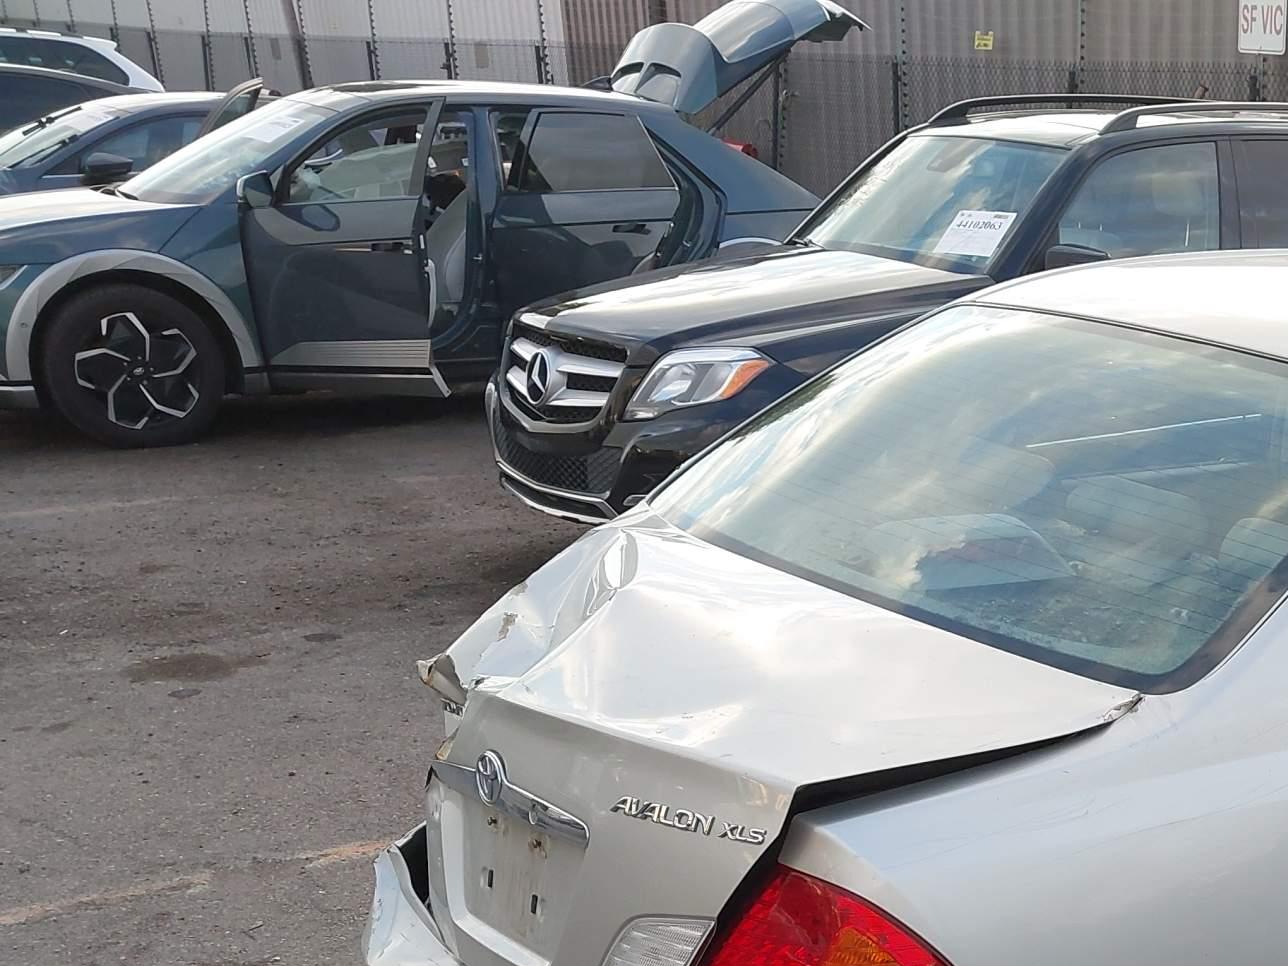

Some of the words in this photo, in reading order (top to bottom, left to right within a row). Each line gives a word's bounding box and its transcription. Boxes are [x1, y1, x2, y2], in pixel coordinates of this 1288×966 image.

[1241, 4, 1257, 34] SF
[1261, 5, 1283, 36] VIC
[956, 219, 1003, 231] 44102063
[610, 795, 715, 836] AVALON
[718, 822, 768, 845] XLS
